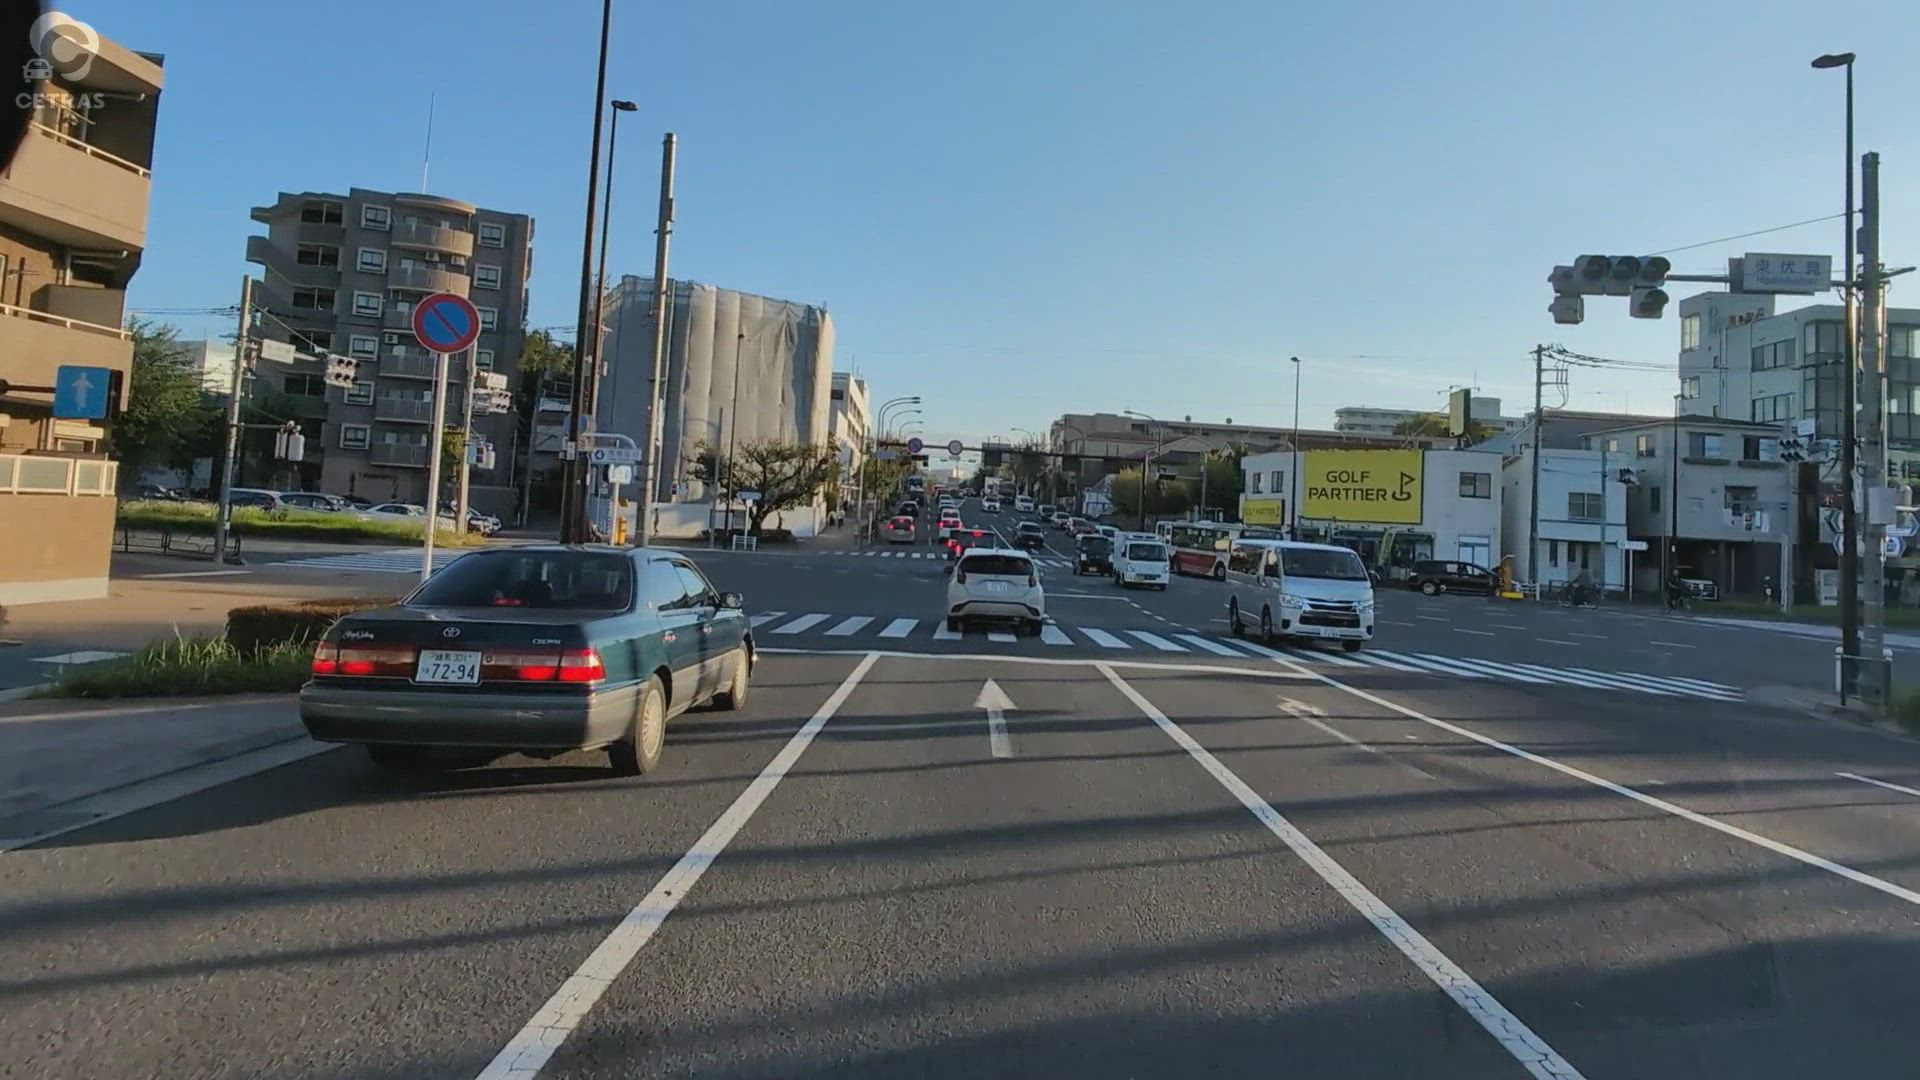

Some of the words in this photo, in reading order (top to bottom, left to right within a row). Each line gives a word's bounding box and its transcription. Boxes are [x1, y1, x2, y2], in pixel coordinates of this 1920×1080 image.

[1326, 470, 1371, 484] GOLF
[1308, 487, 1388, 502] PARTNER
[431, 663, 475, 680] 72-94
